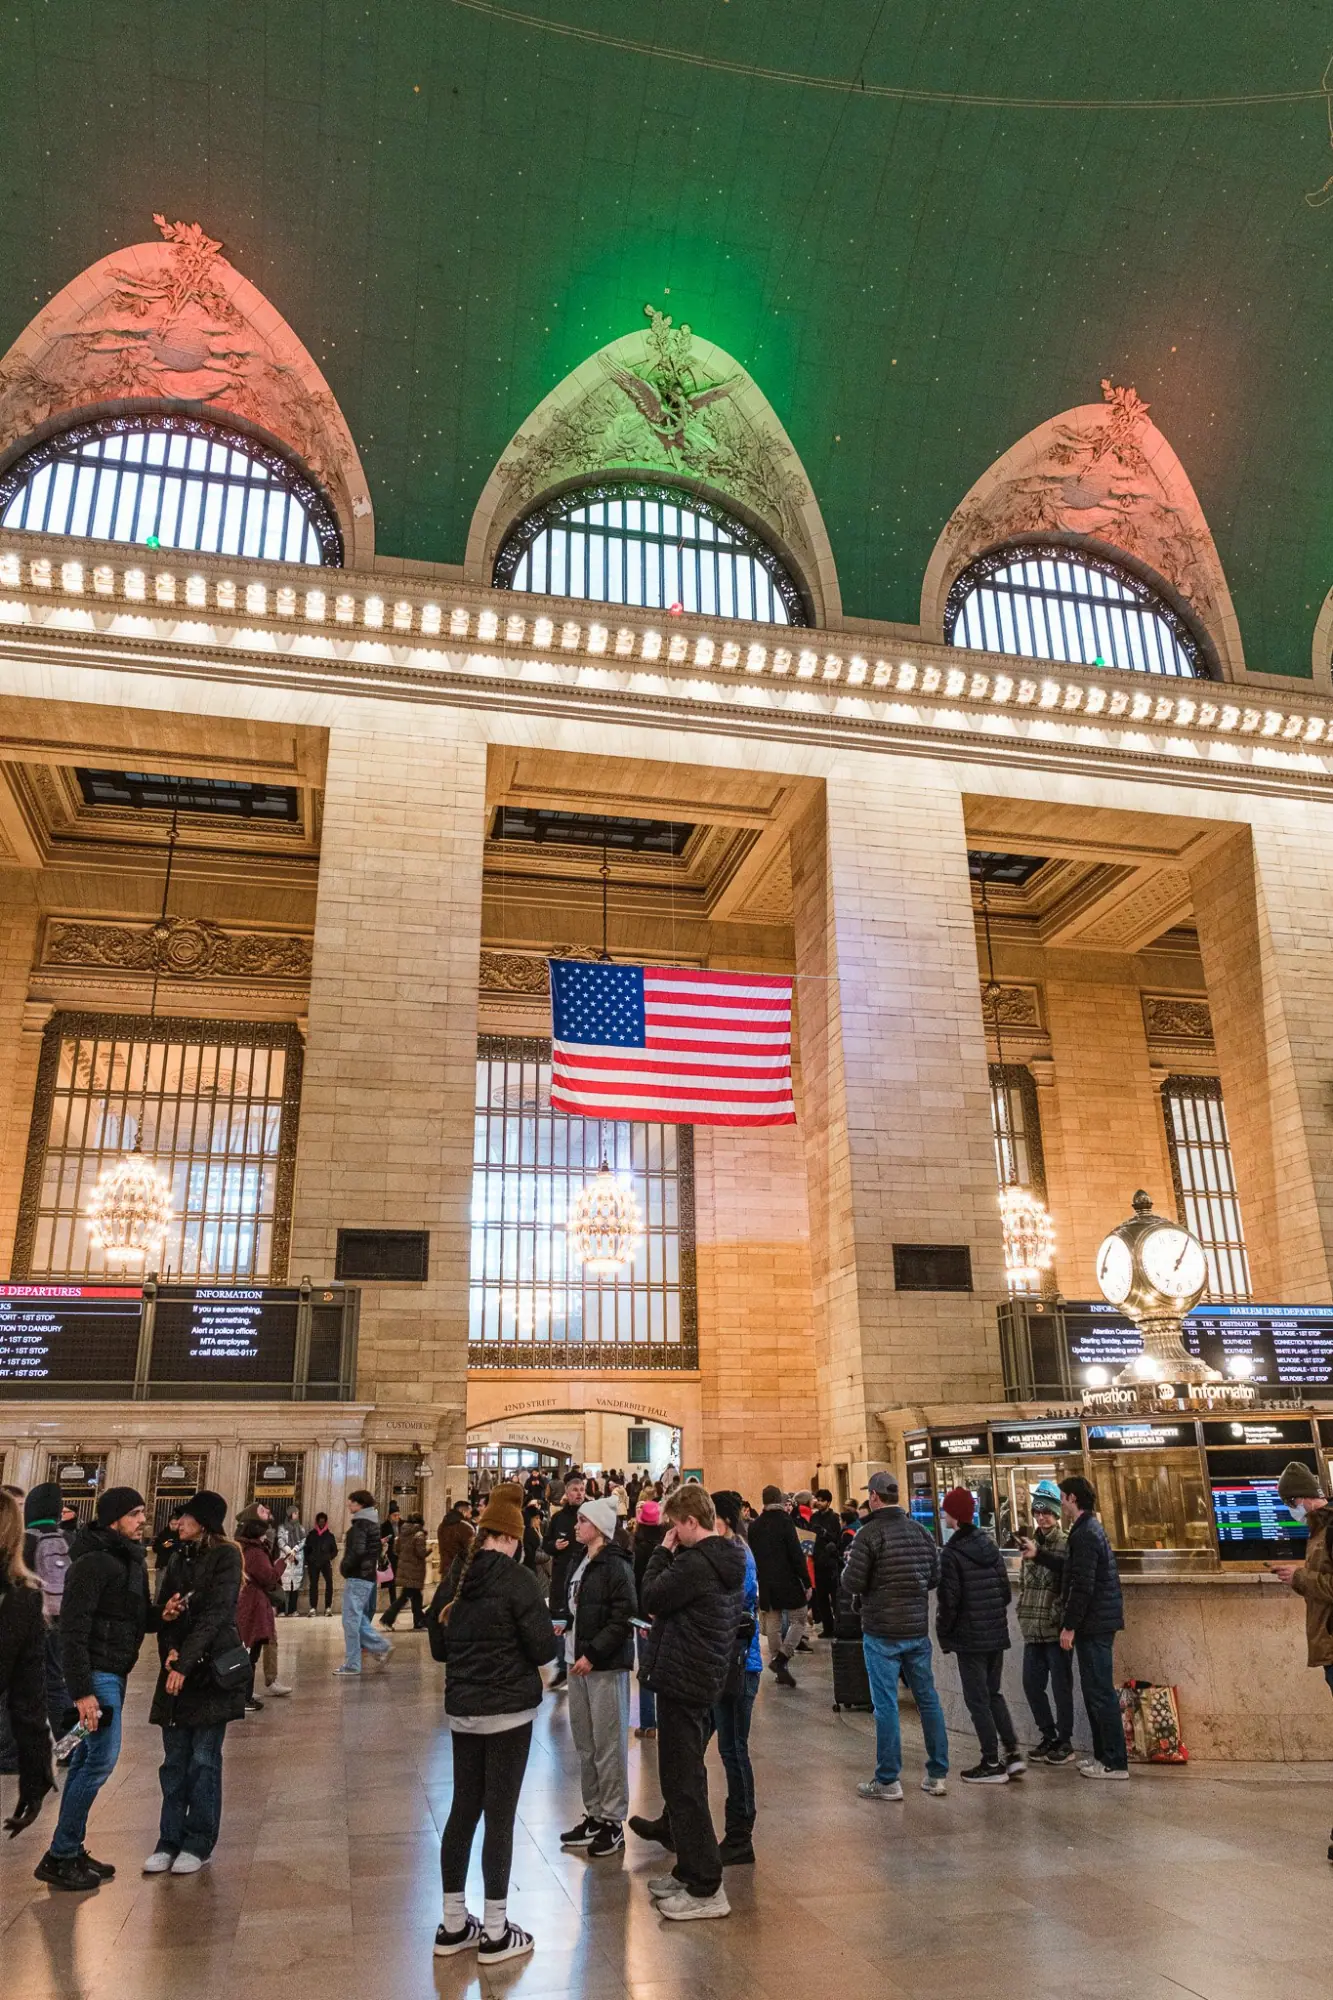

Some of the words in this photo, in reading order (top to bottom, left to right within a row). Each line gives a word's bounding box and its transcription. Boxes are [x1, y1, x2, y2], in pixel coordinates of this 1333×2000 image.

[8, 1286, 82, 1297] DEPARTURES
[196, 1290, 263, 1299] INFORMATION
[1230, 1307, 1262, 1315] HARLEM
[1264, 1307, 1281, 1316] LINE
[1282, 1307, 1333, 1316] DEPARTURES
[215, 1327, 234, 1335] police
[217, 1338, 249, 1346] employee
[1187, 1383, 1255, 1399] Information
[504, 1402, 525, 1412] 42ND
[526, 1399, 557, 1408] STREET
[596, 1398, 647, 1412] VANDERBILT
[647, 1406, 668, 1417] HALL
[387, 1421, 422, 1429] CUSTOMER
[1122, 1428, 1179, 1437] METRO-NORTH
[508, 1433, 529, 1441] BUSES
[532, 1436, 549, 1444] AND
[552, 1440, 572, 1451] TAXIS
[1007, 1435, 1021, 1443] MTA
[1021, 1433, 1068, 1442] METRO-NORTH
[1120, 1436, 1165, 1445] TIMETABLES
[1019, 1440, 1056, 1449] TIMETABLES
